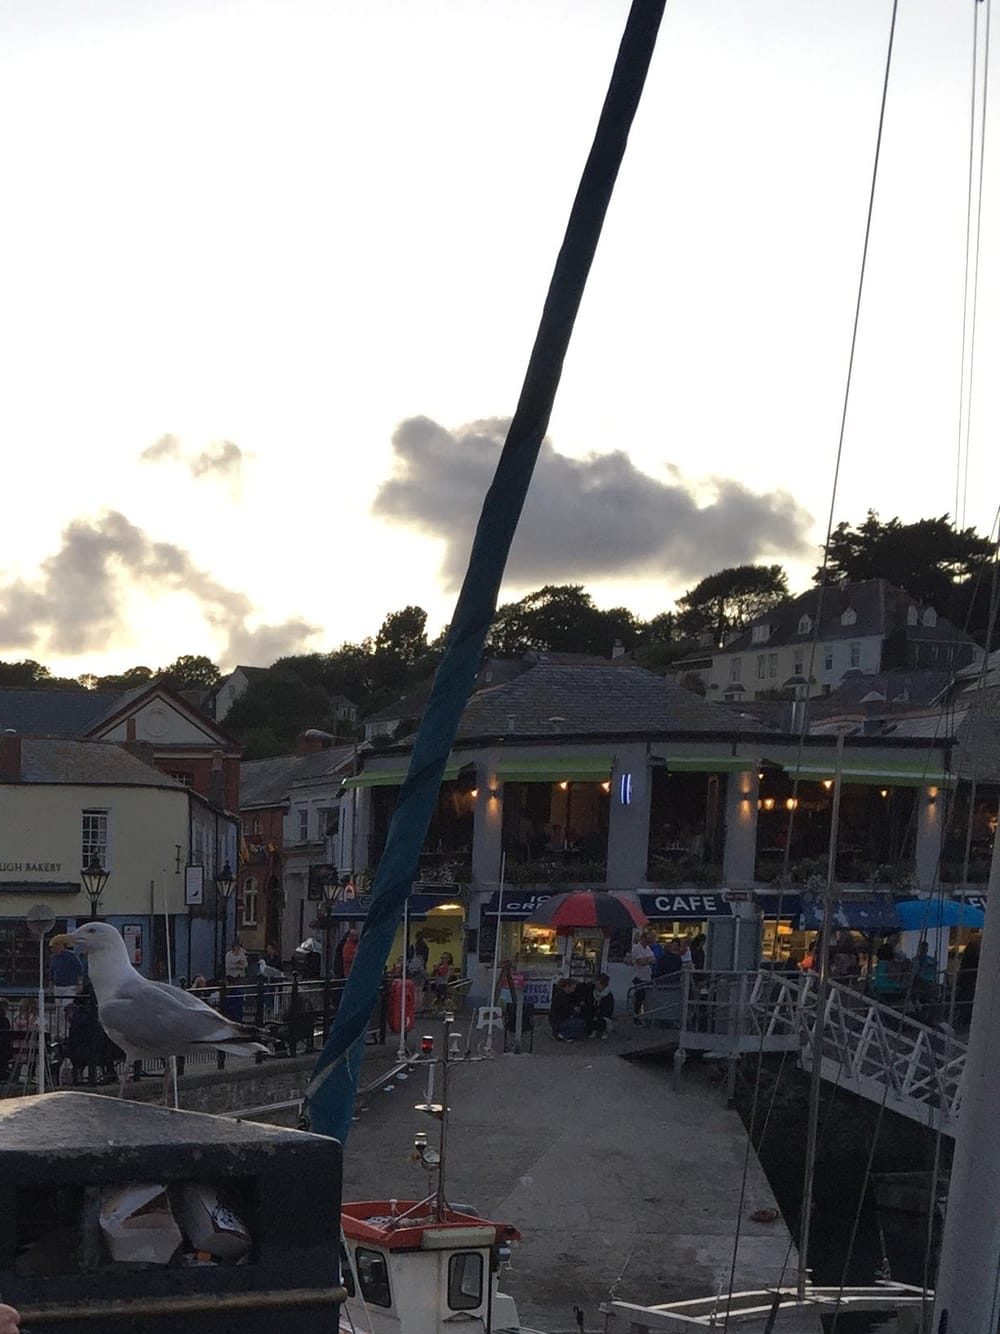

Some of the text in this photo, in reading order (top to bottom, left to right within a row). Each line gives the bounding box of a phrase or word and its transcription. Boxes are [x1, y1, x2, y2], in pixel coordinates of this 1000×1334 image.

[25, 863, 62, 872] BAKERY
[530, 895, 552, 903] IC
[655, 896, 717, 912] CAFE
